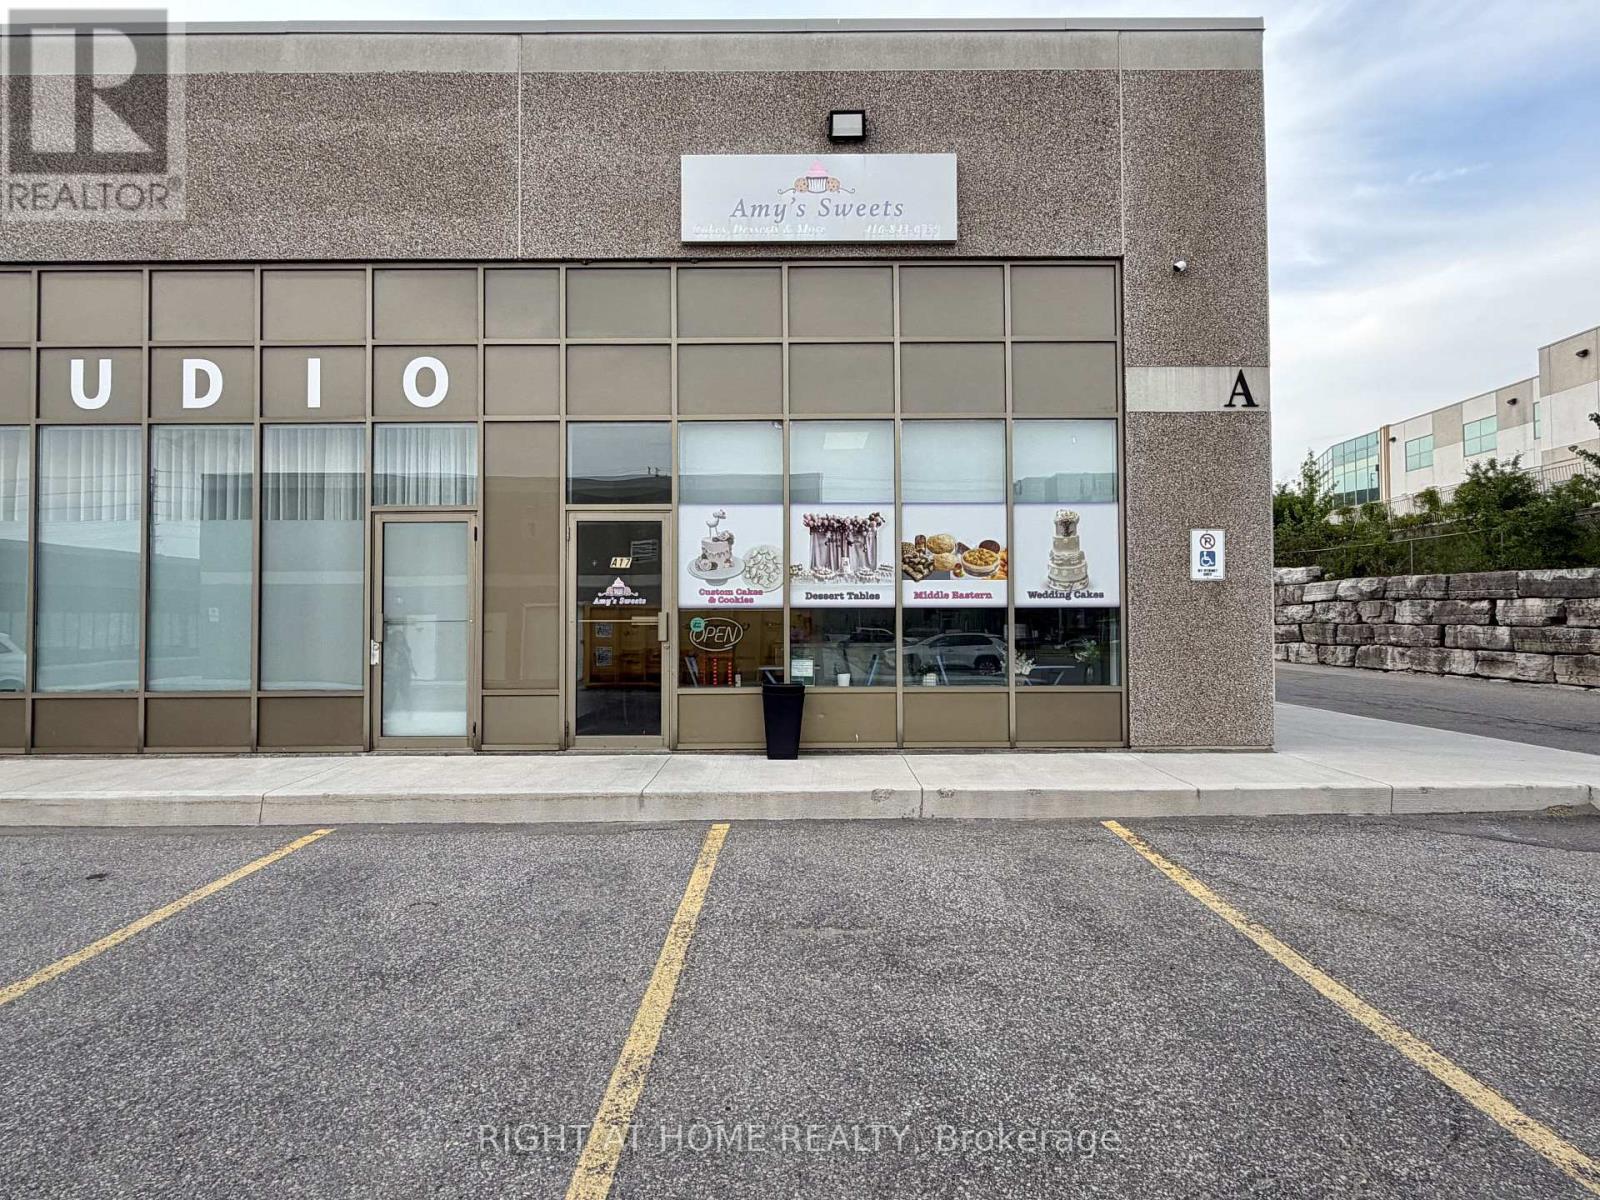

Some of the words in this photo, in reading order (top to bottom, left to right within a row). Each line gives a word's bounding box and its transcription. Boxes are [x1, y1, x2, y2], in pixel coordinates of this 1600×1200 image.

[730, 198, 806, 224] Amy's
[818, 198, 904, 217] Sweets
[1224, 368, 1259, 408] A
[611, 558, 632, 568] A17
[805, 592, 844, 600] Dessert
[847, 591, 880, 600] Tables
[914, 591, 949, 600] Middle
[952, 591, 992, 600] Eastern
[1028, 591, 1071, 601] Wedding
[1074, 591, 1104, 599] Cakes
[593, 597, 617, 606] Amy's
[619, 597, 647, 605] Sweets
[693, 626, 738, 643] OPEN
